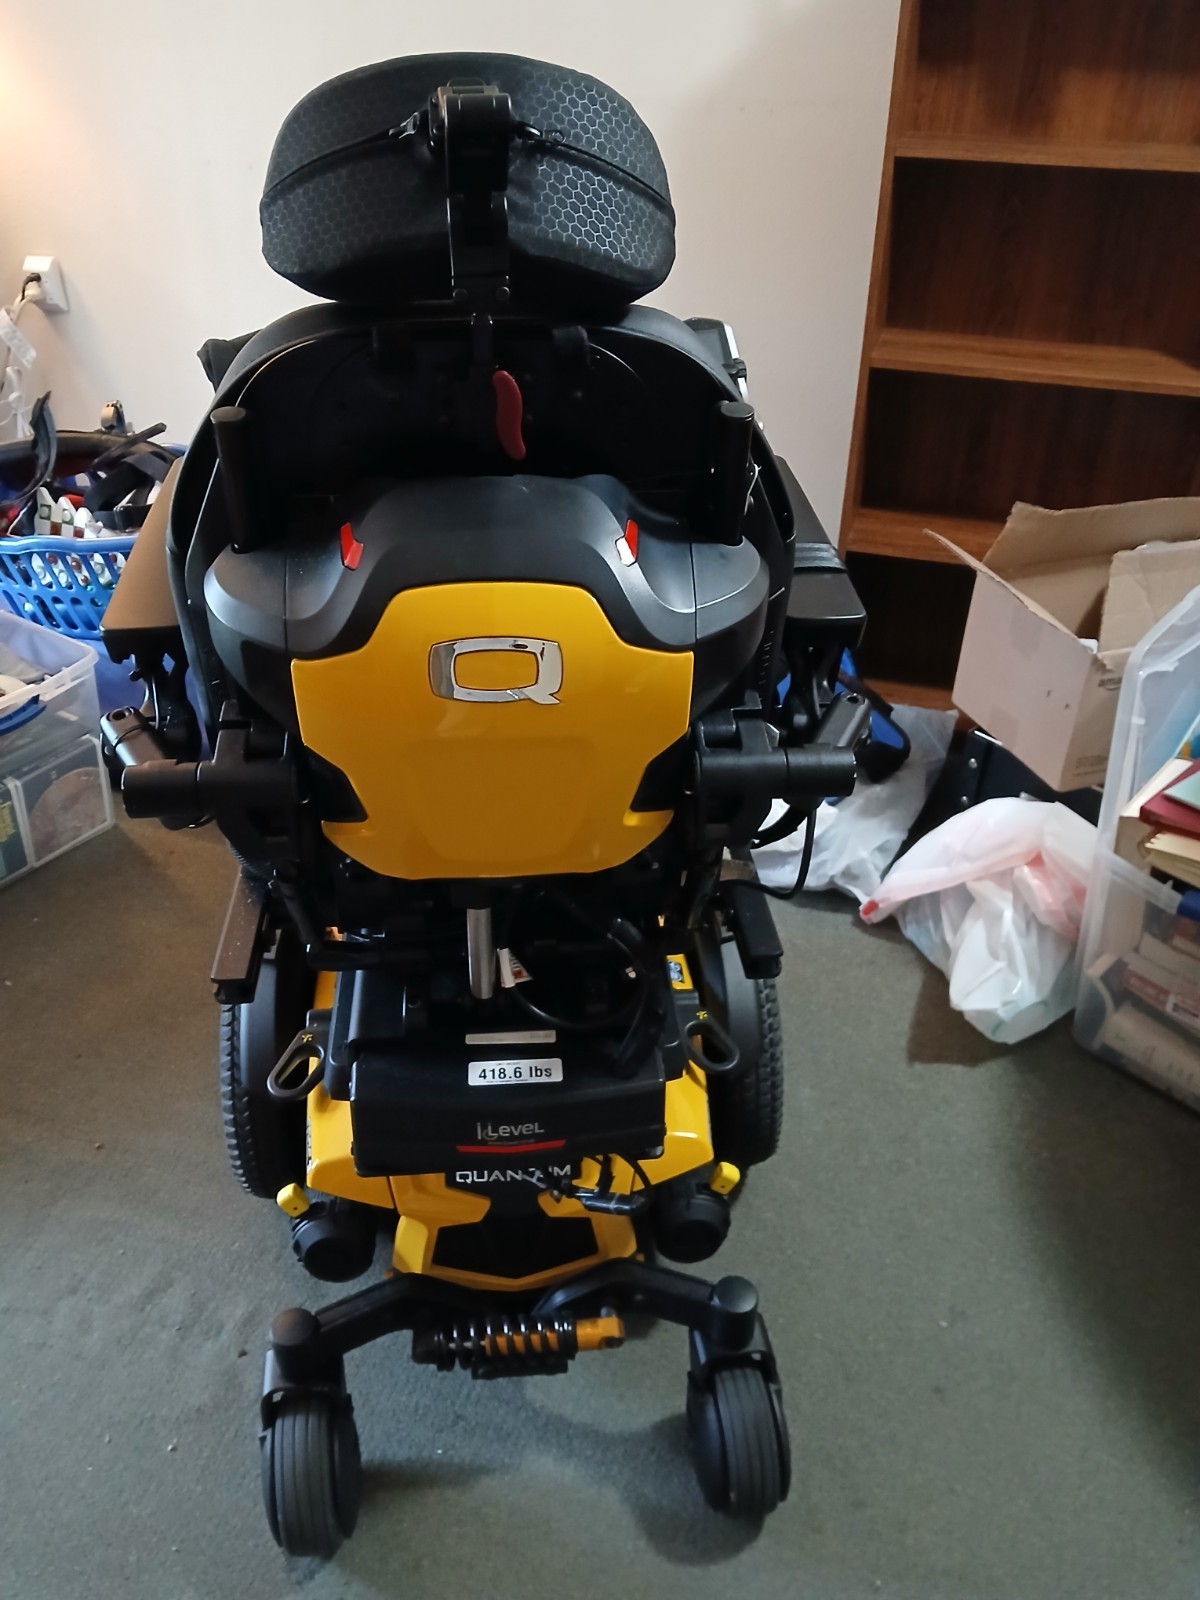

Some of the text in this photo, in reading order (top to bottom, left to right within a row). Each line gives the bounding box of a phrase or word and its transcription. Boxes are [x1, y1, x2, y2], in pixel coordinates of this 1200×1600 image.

[428, 636, 563, 704] Q
[478, 1065, 552, 1080] 418.6 lbs
[455, 1164, 571, 1184] QUANM
